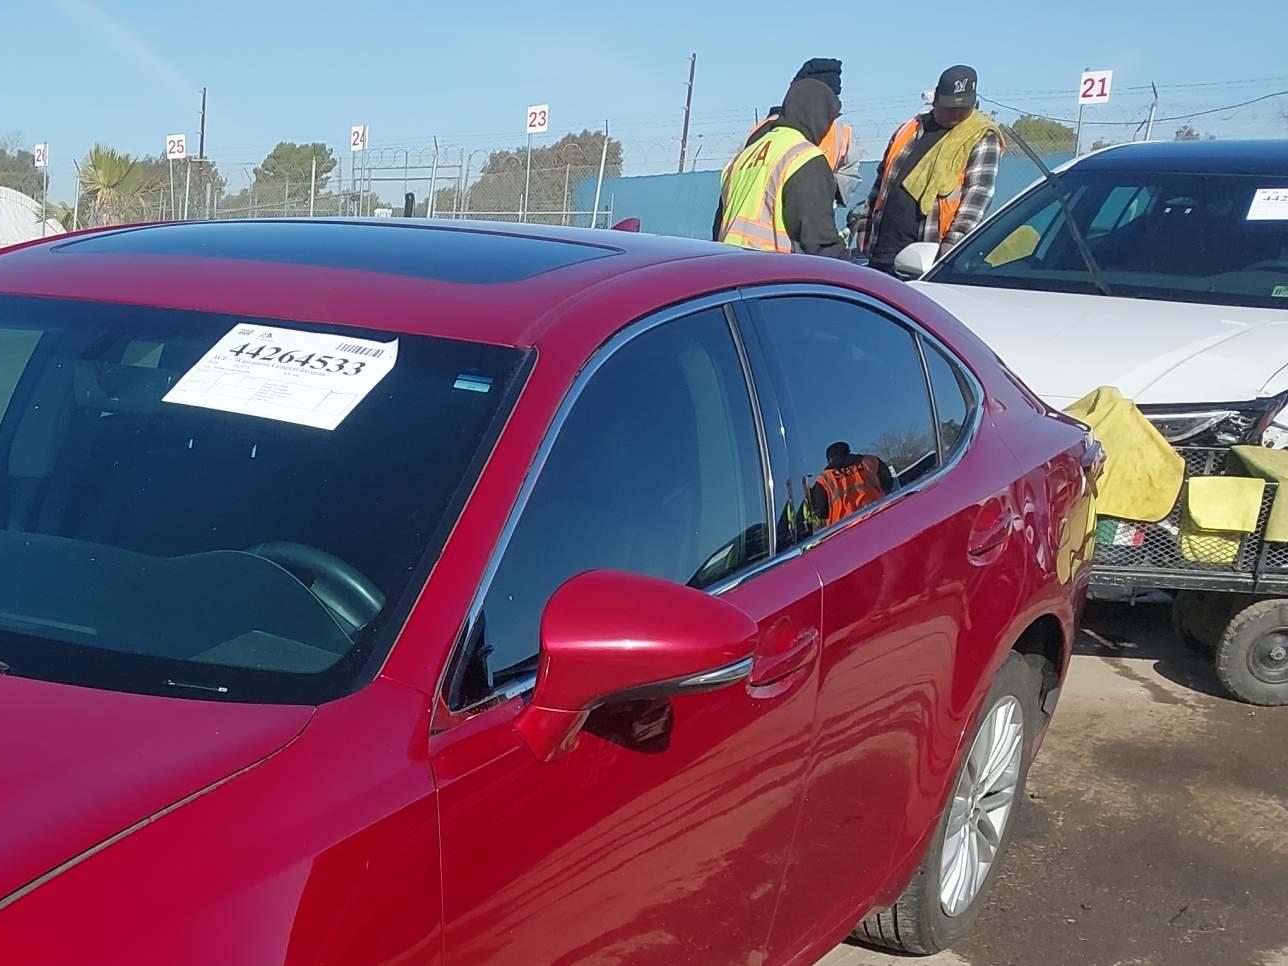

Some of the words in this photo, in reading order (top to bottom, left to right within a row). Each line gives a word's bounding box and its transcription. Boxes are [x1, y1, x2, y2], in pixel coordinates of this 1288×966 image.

[1081, 76, 1108, 98] 21
[528, 110, 548, 128] 23
[168, 139, 185, 155] 25
[229, 342, 366, 376] 44264533
